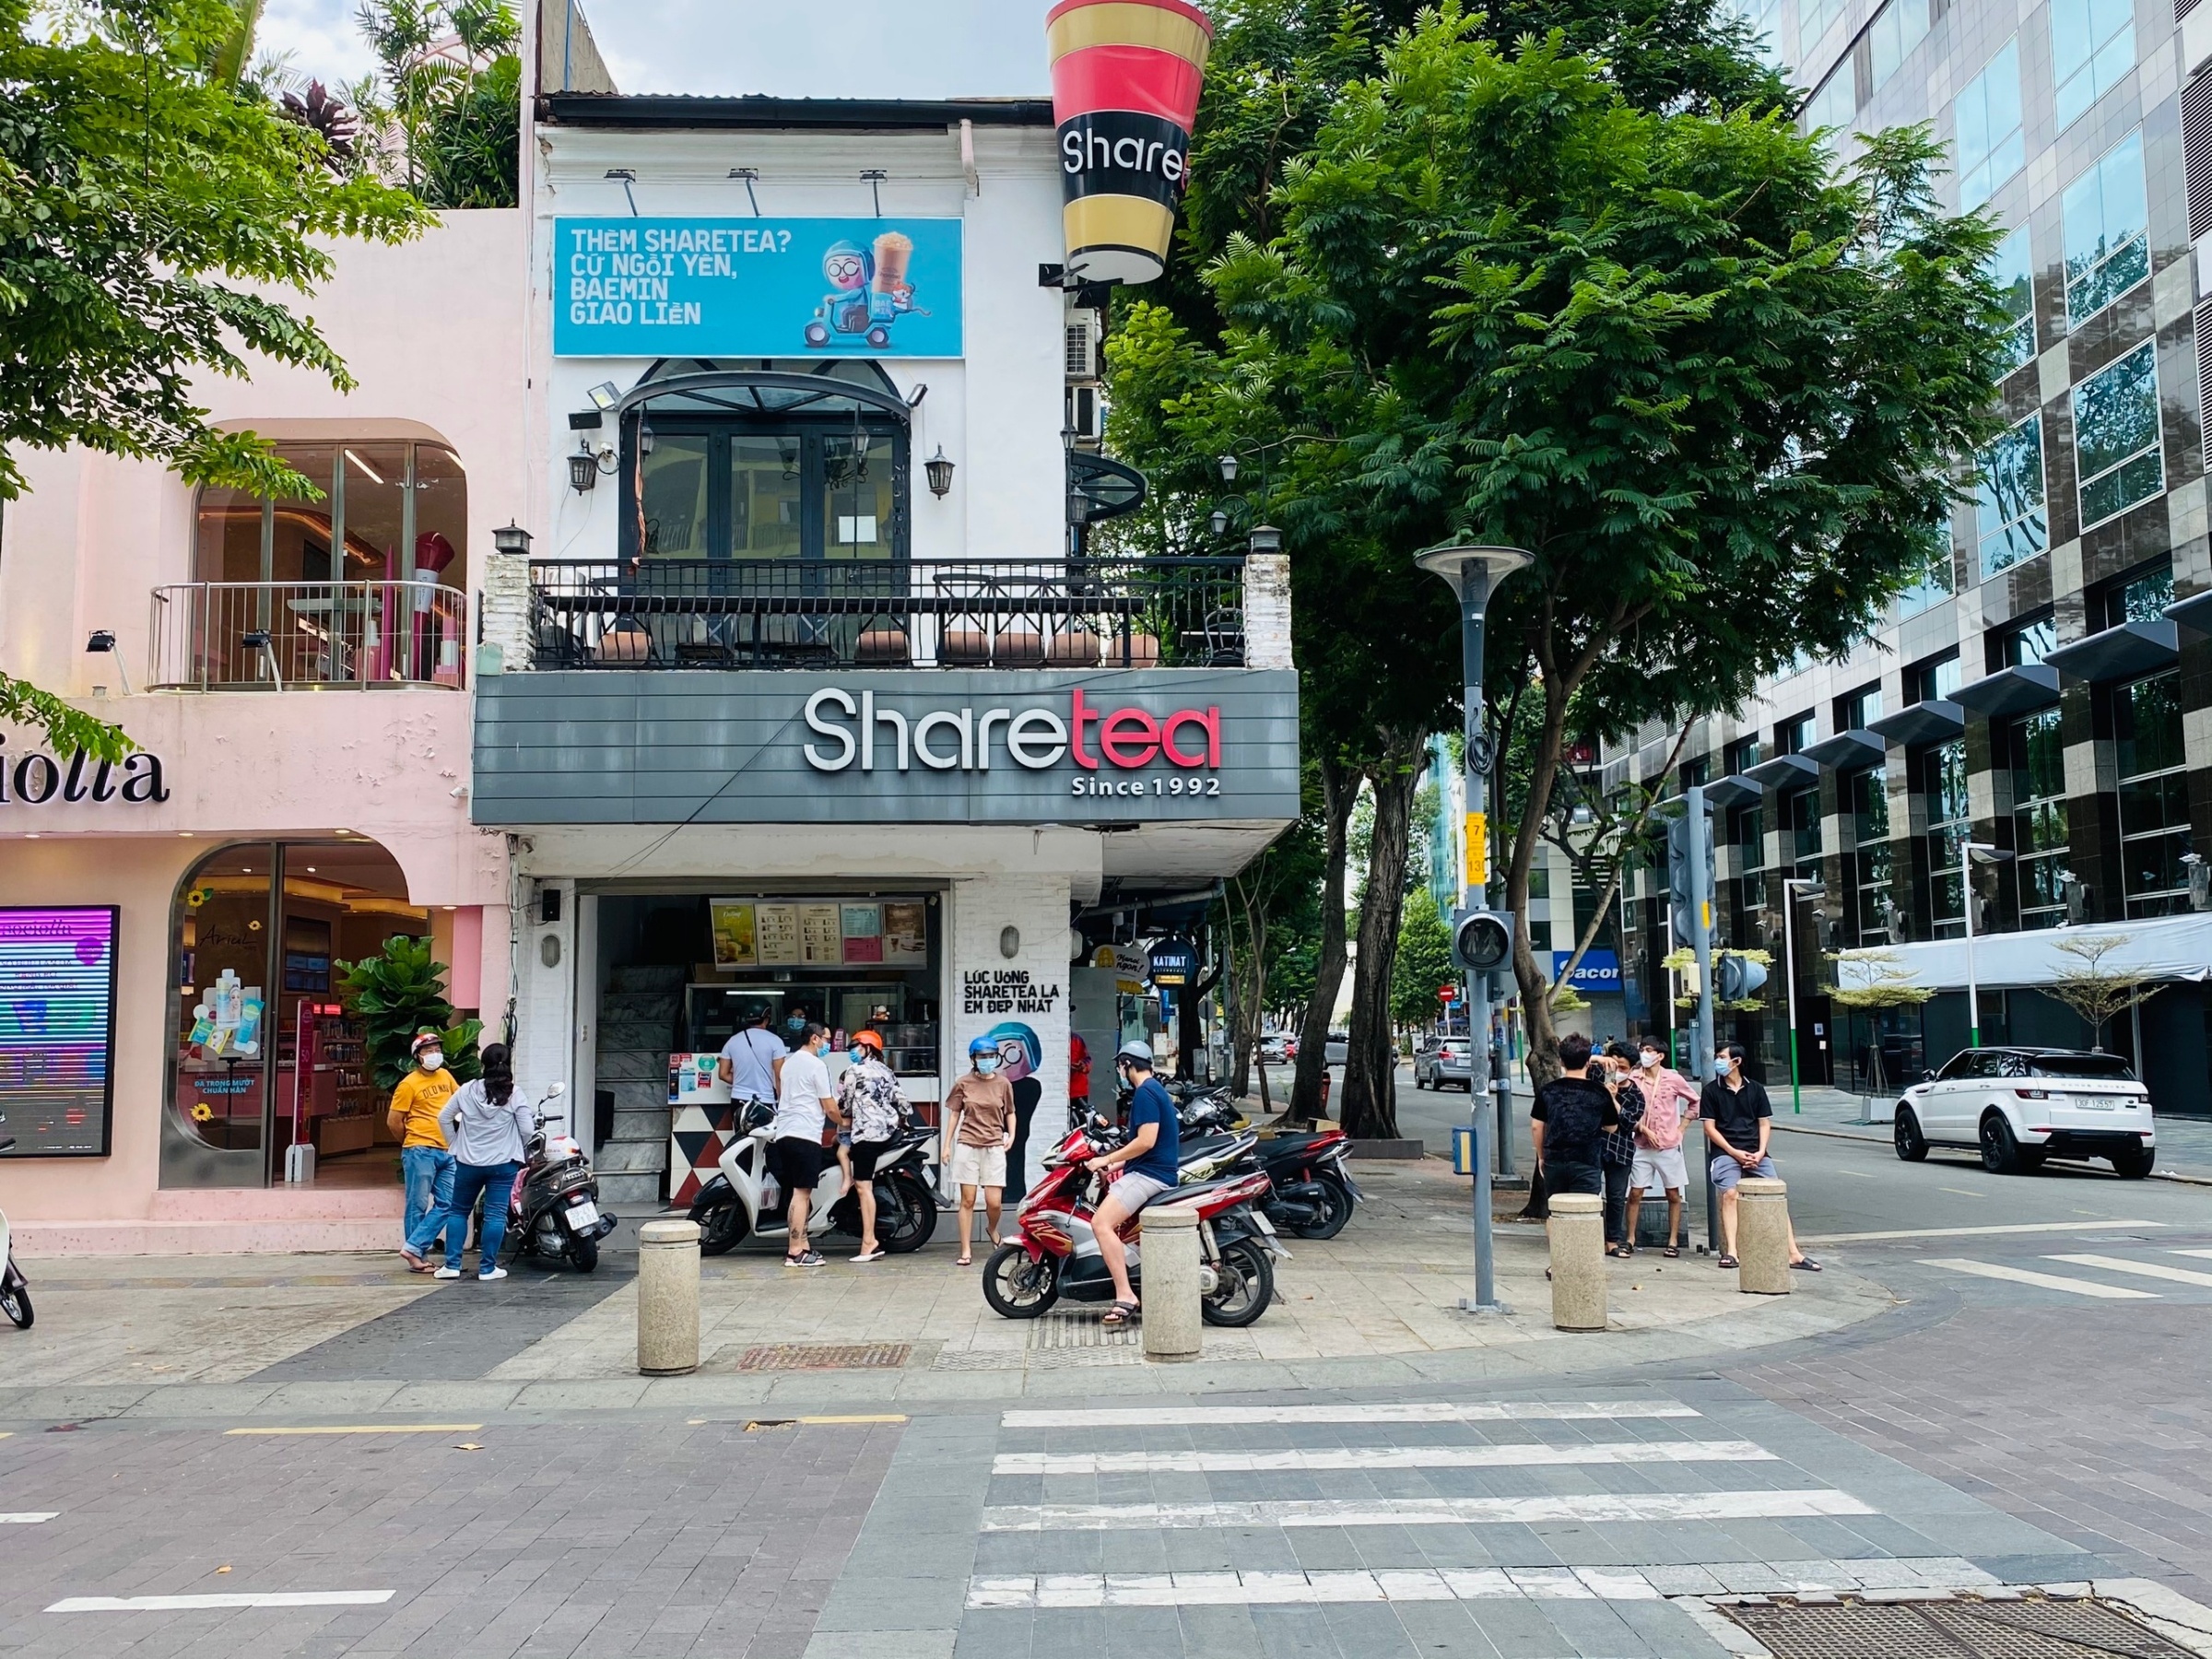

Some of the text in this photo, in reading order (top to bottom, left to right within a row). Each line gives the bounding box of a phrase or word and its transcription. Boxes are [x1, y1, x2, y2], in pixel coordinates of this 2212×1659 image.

[571, 229, 792, 253] THÈM SHARETEA?
[571, 253, 737, 279] CỨ NGỒI YÊN,
[571, 277, 668, 300] BAEMIN
[570, 301, 700, 325] GIAO LIỀN
[804, 687, 1220, 771] Sharetea
[1071, 776, 1221, 796] Since 1992
[1473, 824, 1480, 836] 7
[1153, 955, 1187, 967] KATINAT
[964, 970, 991, 984] LÚC
[964, 984, 1038, 999] SHARETEA
[964, 1000, 983, 1014] EM
